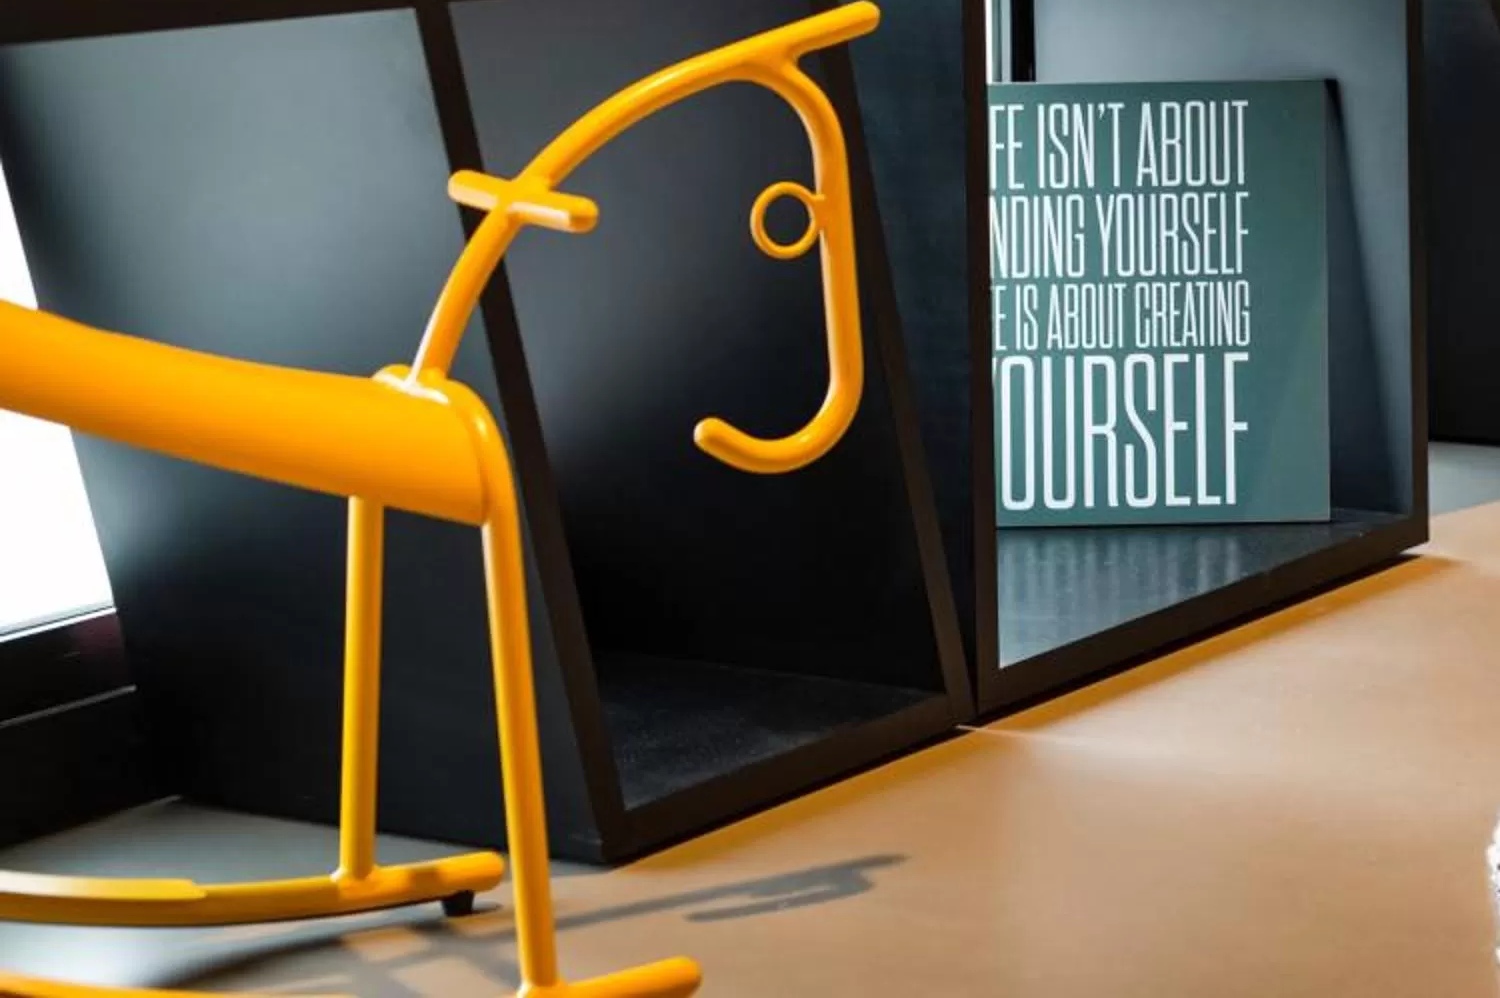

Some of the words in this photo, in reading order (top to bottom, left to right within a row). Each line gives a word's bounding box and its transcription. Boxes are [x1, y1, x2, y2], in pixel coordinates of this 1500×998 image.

[989, 103, 1025, 190] FE
[1037, 102, 1124, 189] ISN'T
[1136, 100, 1249, 188] ABOUT
[989, 195, 1085, 279] NDING
[1095, 191, 1249, 277] YOURSELF
[991, 284, 1008, 351] E
[1015, 283, 1039, 351] IS
[1046, 281, 1127, 350] ABOUT
[1134, 280, 1250, 348] CREATING
[992, 352, 1249, 511] OURSELF
